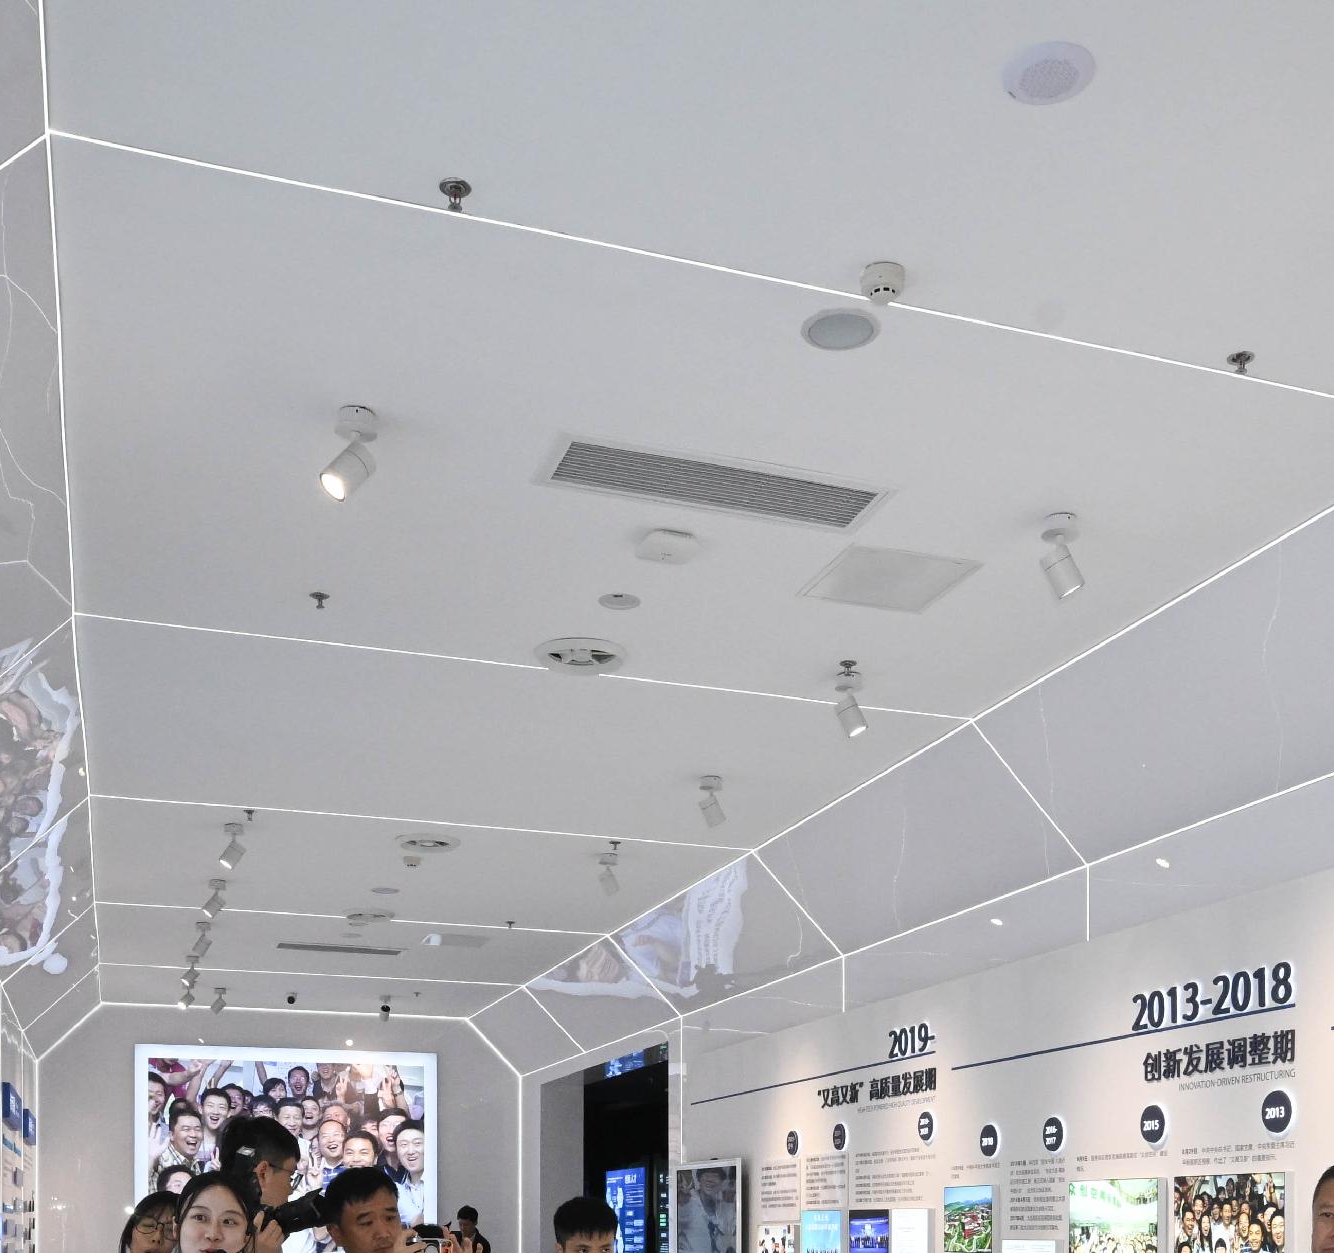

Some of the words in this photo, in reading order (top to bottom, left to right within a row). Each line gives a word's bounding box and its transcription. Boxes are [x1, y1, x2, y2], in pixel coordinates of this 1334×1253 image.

[1132, 961, 1292, 1031] 2013-2018
[889, 1023, 935, 1059] 2019-
[1143, 1029, 1295, 1082] 创新发展调整期
[870, 1067, 937, 1101] 高质量发展期
[1179, 1077, 1240, 1091] INNOVATION-DRIVEN
[1241, 1069, 1296, 1084] RESTRUCTURING
[1143, 1119, 1159, 1131] 2015
[1265, 1106, 1285, 1119] 2013
